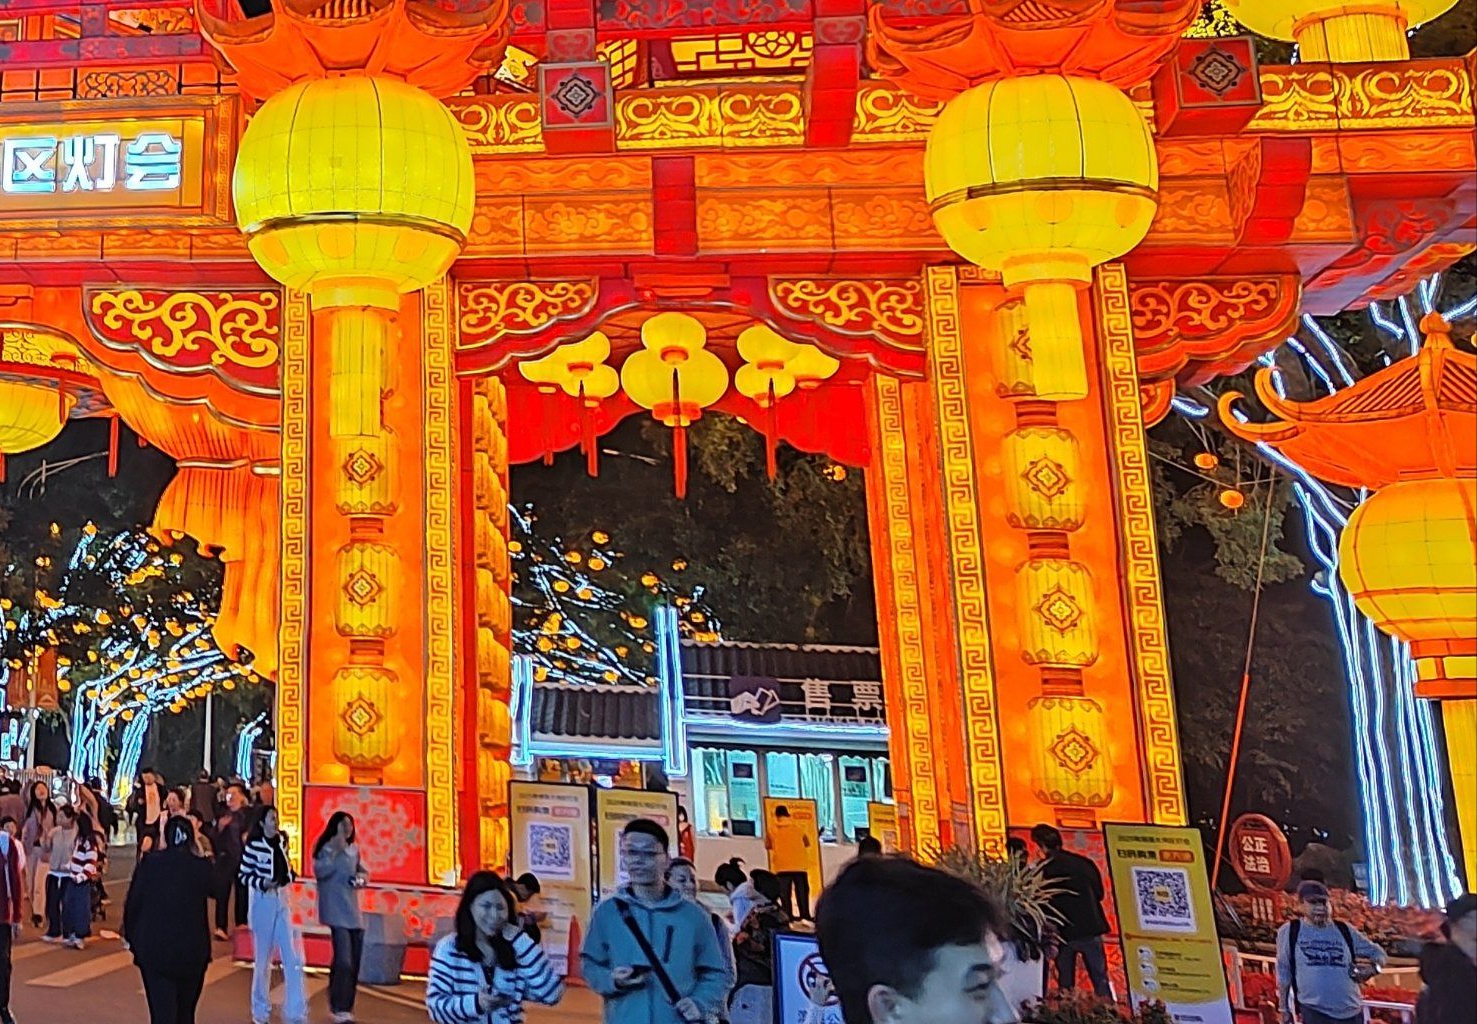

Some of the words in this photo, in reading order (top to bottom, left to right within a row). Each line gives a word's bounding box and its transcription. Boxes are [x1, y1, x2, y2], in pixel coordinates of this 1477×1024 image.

[801, 678, 883, 711] 售票
[1242, 836, 1269, 854] 公正
[1243, 855, 1271, 874] 法治
